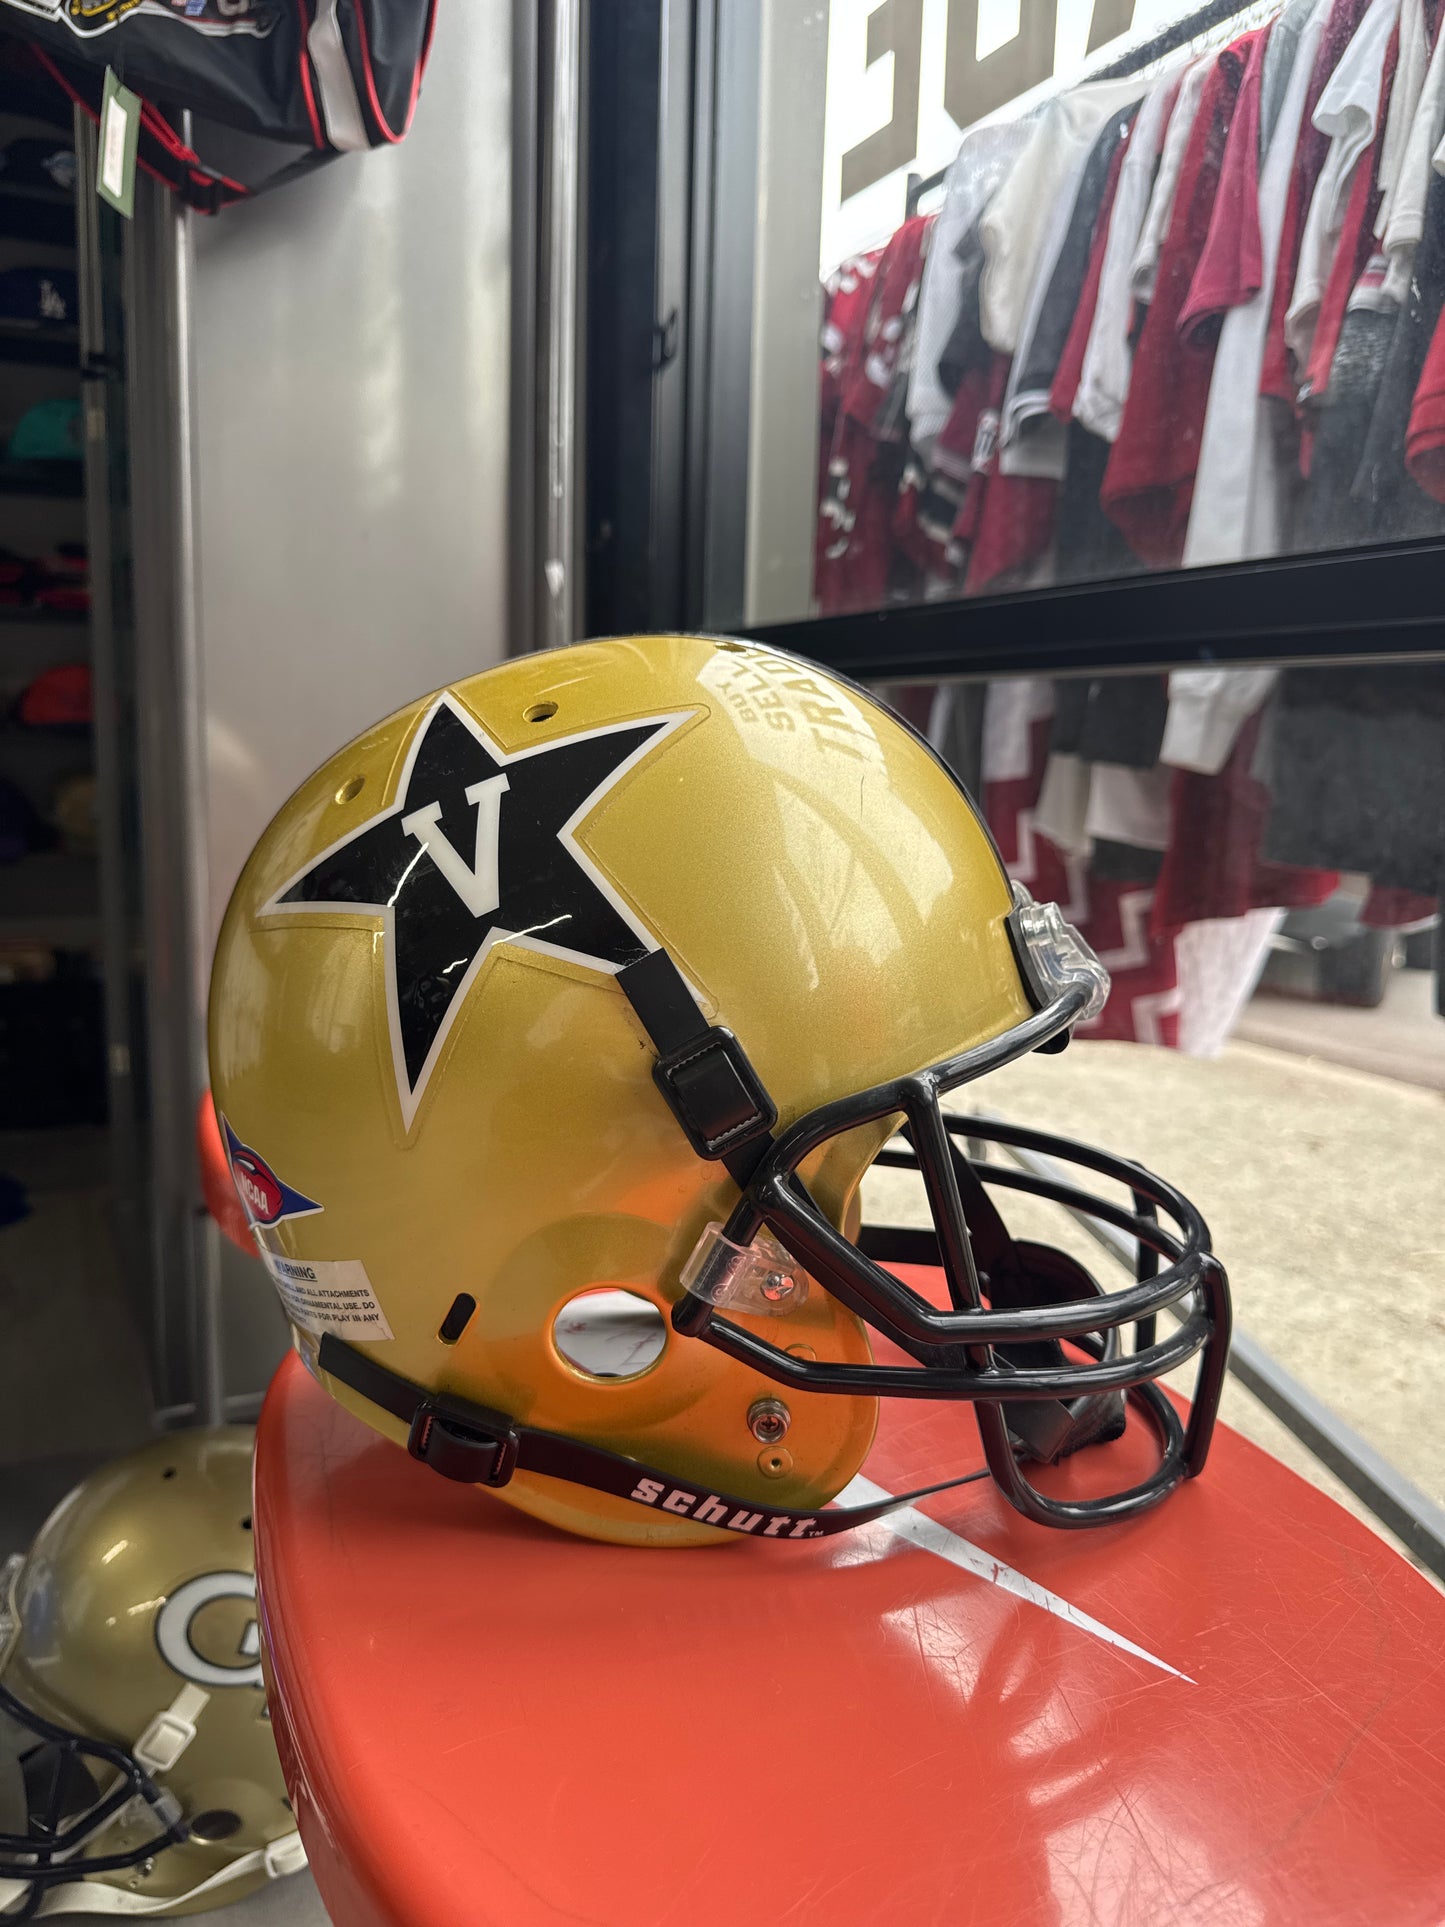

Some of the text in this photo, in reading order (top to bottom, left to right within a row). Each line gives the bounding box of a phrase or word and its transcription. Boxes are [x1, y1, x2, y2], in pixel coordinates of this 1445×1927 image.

[401, 772, 511, 918] V
[318, 1289, 370, 1298] ATTACHMENTS
[343, 1302, 361, 1310] USE.
[362, 1301, 376, 1309] DO
[317, 1312, 332, 1321] FOR
[332, 1313, 350, 1322] PLAY
[351, 1313, 362, 1322] IN
[363, 1313, 380, 1322] ANY
[630, 1477, 817, 1538] schutt
